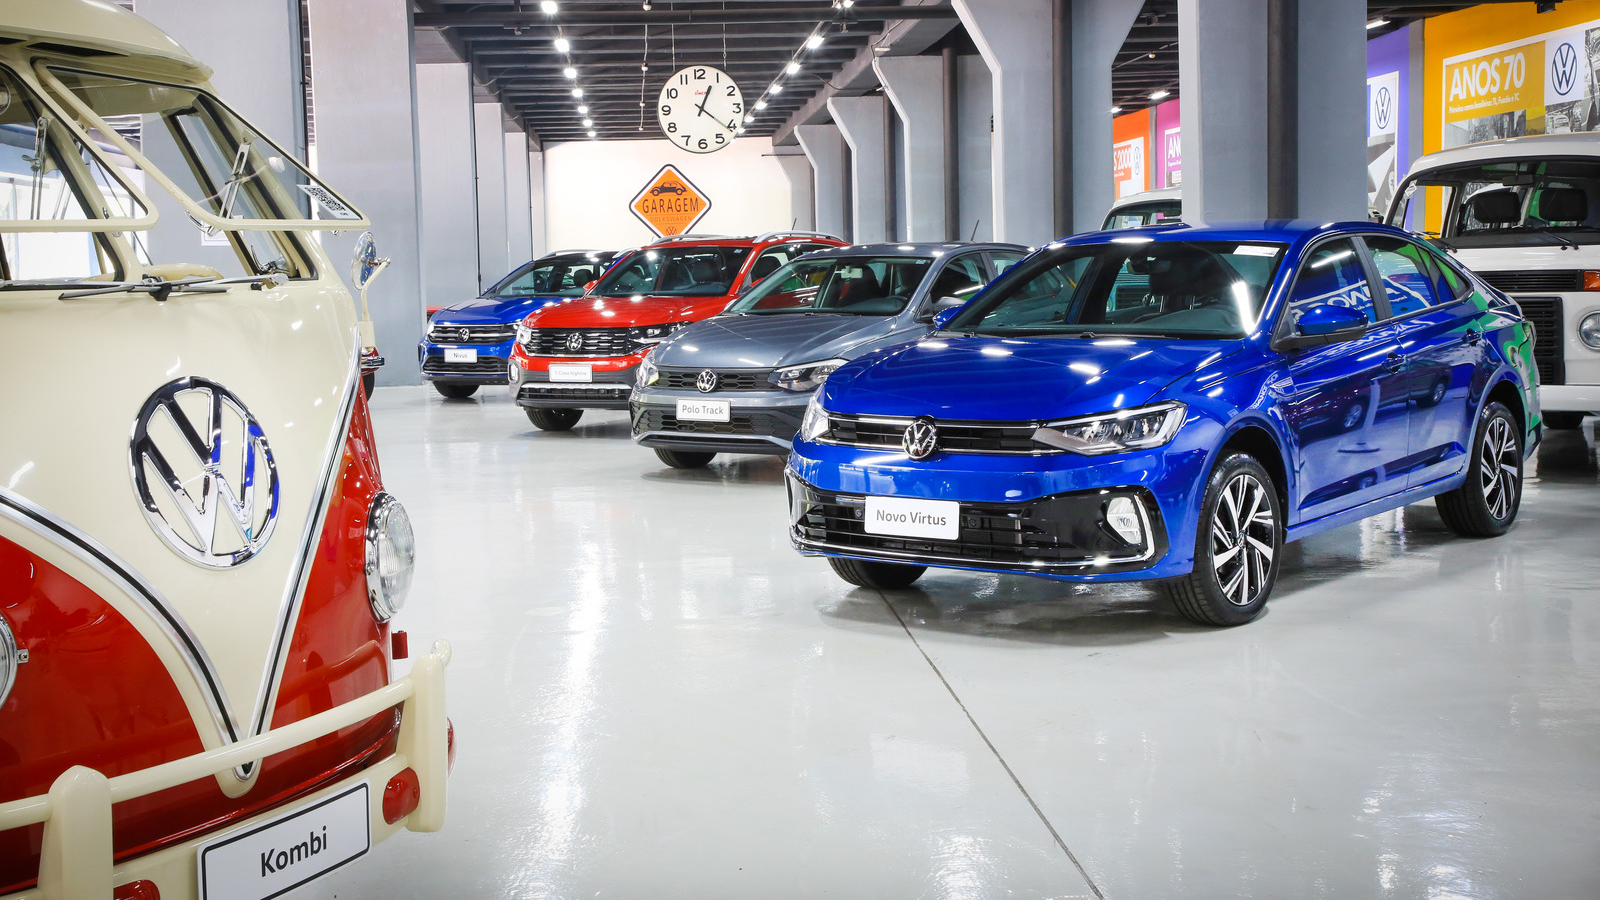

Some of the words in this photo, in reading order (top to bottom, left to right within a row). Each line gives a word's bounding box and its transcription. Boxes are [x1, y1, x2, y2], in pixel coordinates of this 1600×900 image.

[680, 74, 688, 85] 11
[694, 69, 706, 80] 12
[716, 72, 720, 84] 1
[1449, 58, 1501, 102] ANOS
[1503, 52, 1526, 91] 70
[667, 88, 678, 99] 10
[726, 85, 736, 97] 2
[661, 105, 671, 116] 9
[732, 103, 742, 114] 3
[667, 122, 677, 133] 8
[727, 119, 737, 131] 4
[681, 135, 691, 146] 7
[715, 133, 725, 144] 5
[698, 139, 708, 150] 6
[1117, 147, 1132, 170] 2000
[642, 198, 699, 213] GARAGEM
[682, 404, 700, 414] Polo
[702, 405, 724, 415] Track
[876, 509, 907, 523] Novo
[910, 511, 947, 526] Virtus
[261, 825, 327, 878] Kombi
